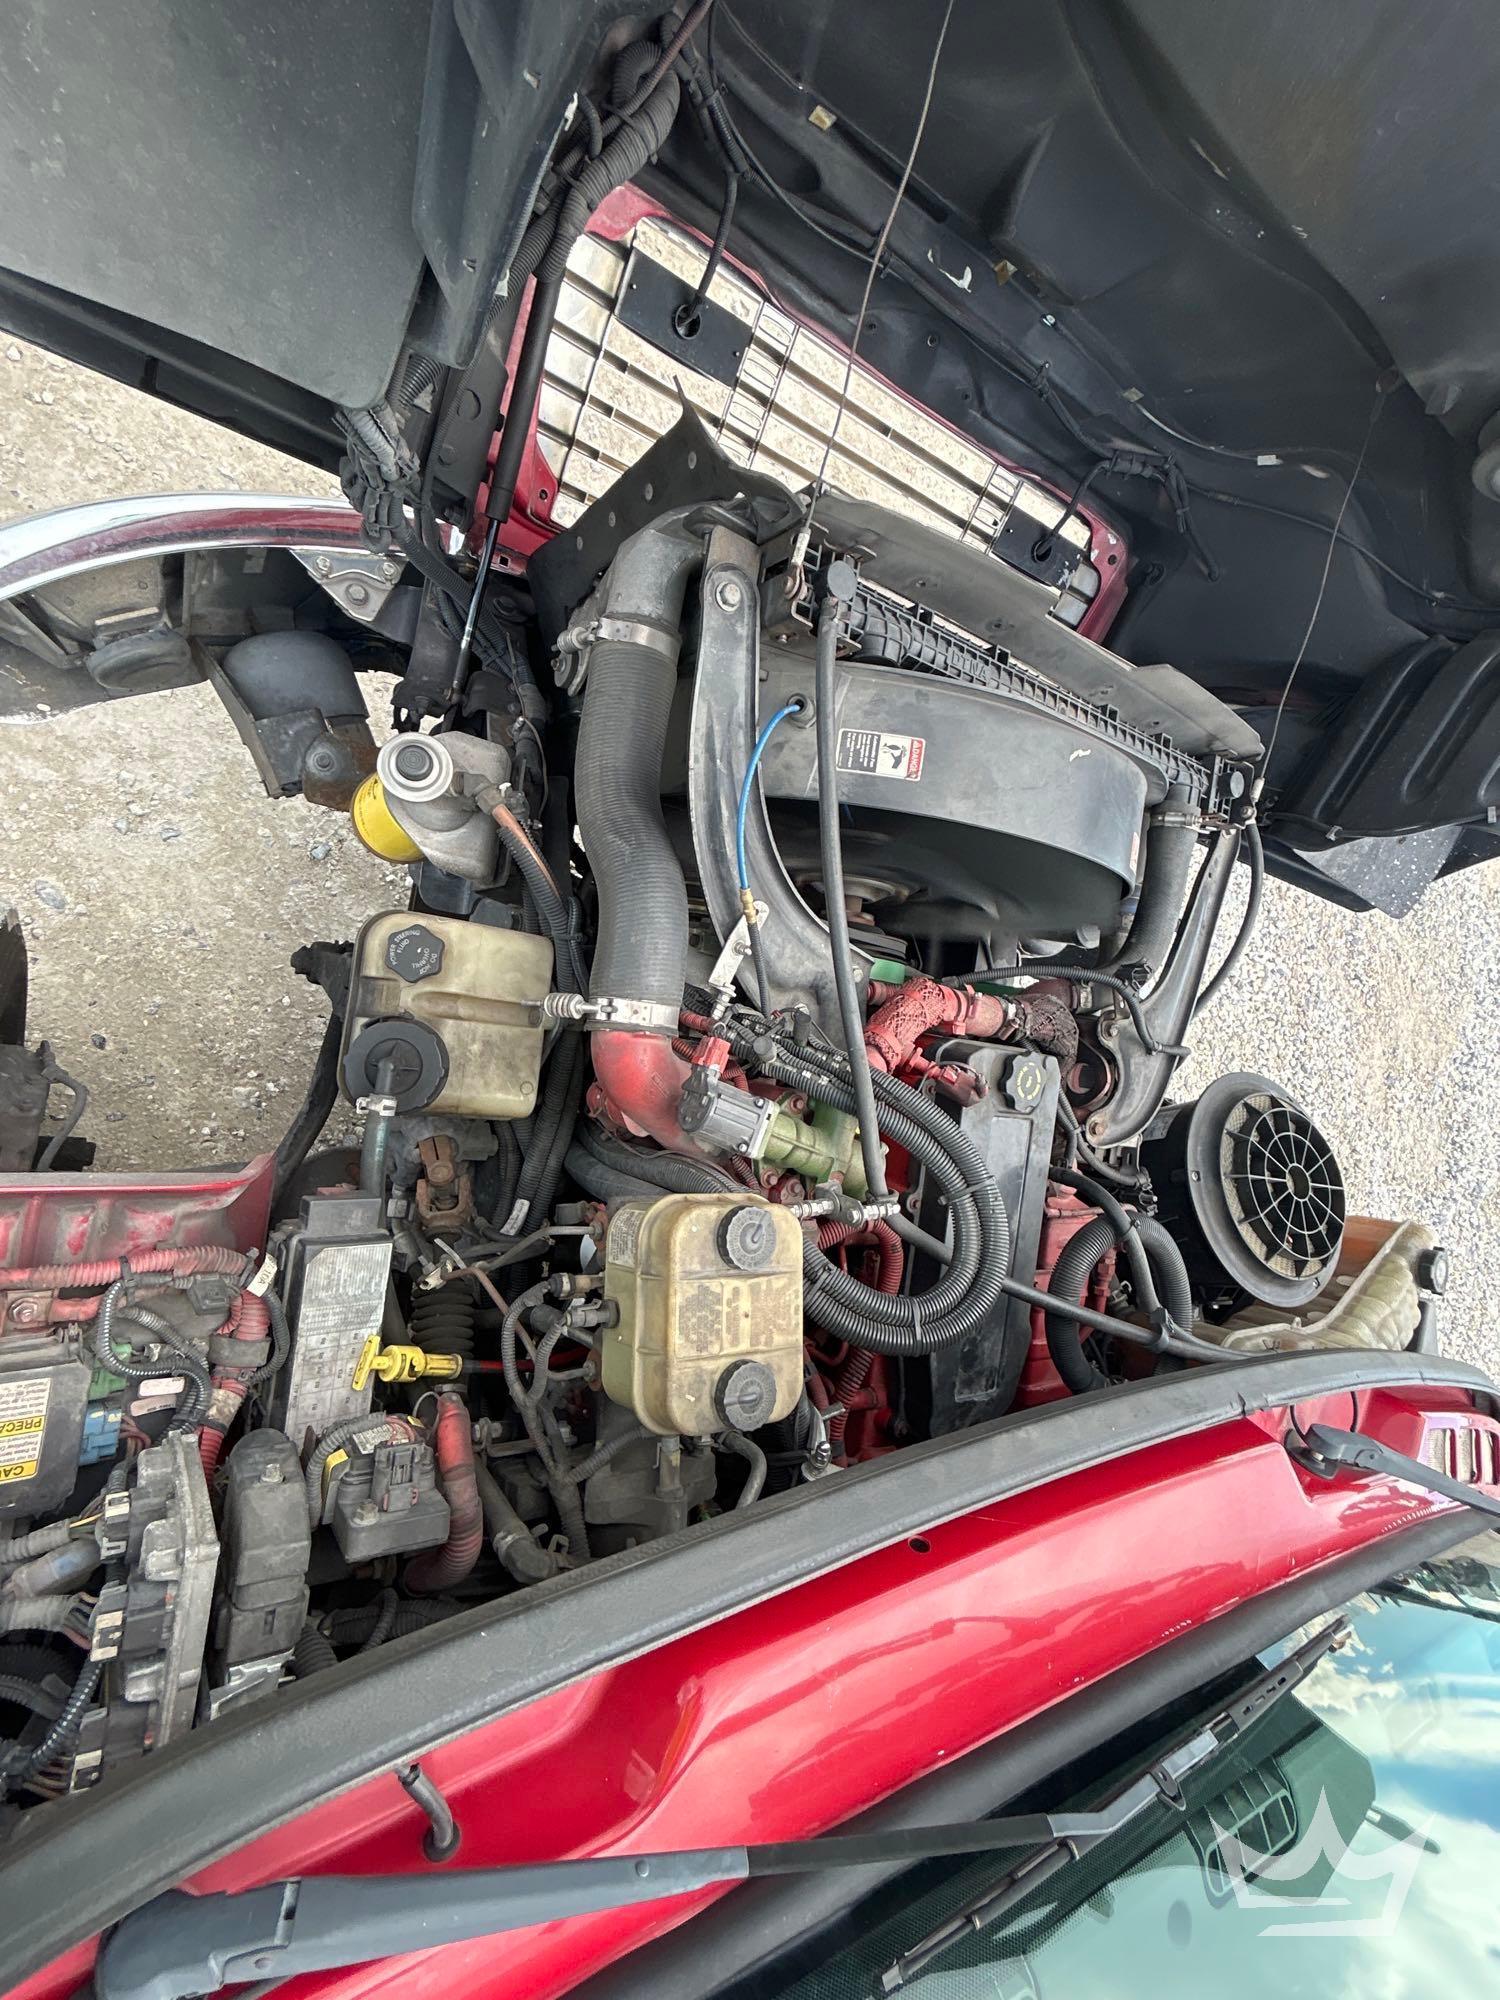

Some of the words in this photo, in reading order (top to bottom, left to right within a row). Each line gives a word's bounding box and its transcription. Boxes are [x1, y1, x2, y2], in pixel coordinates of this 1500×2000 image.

[951, 649, 987, 681] DTNA
[394, 930, 420, 943] STEERING
[397, 939, 410, 953] FLUID
[412, 947, 430, 968] OVERFILL
[430, 953, 438, 963] DO
